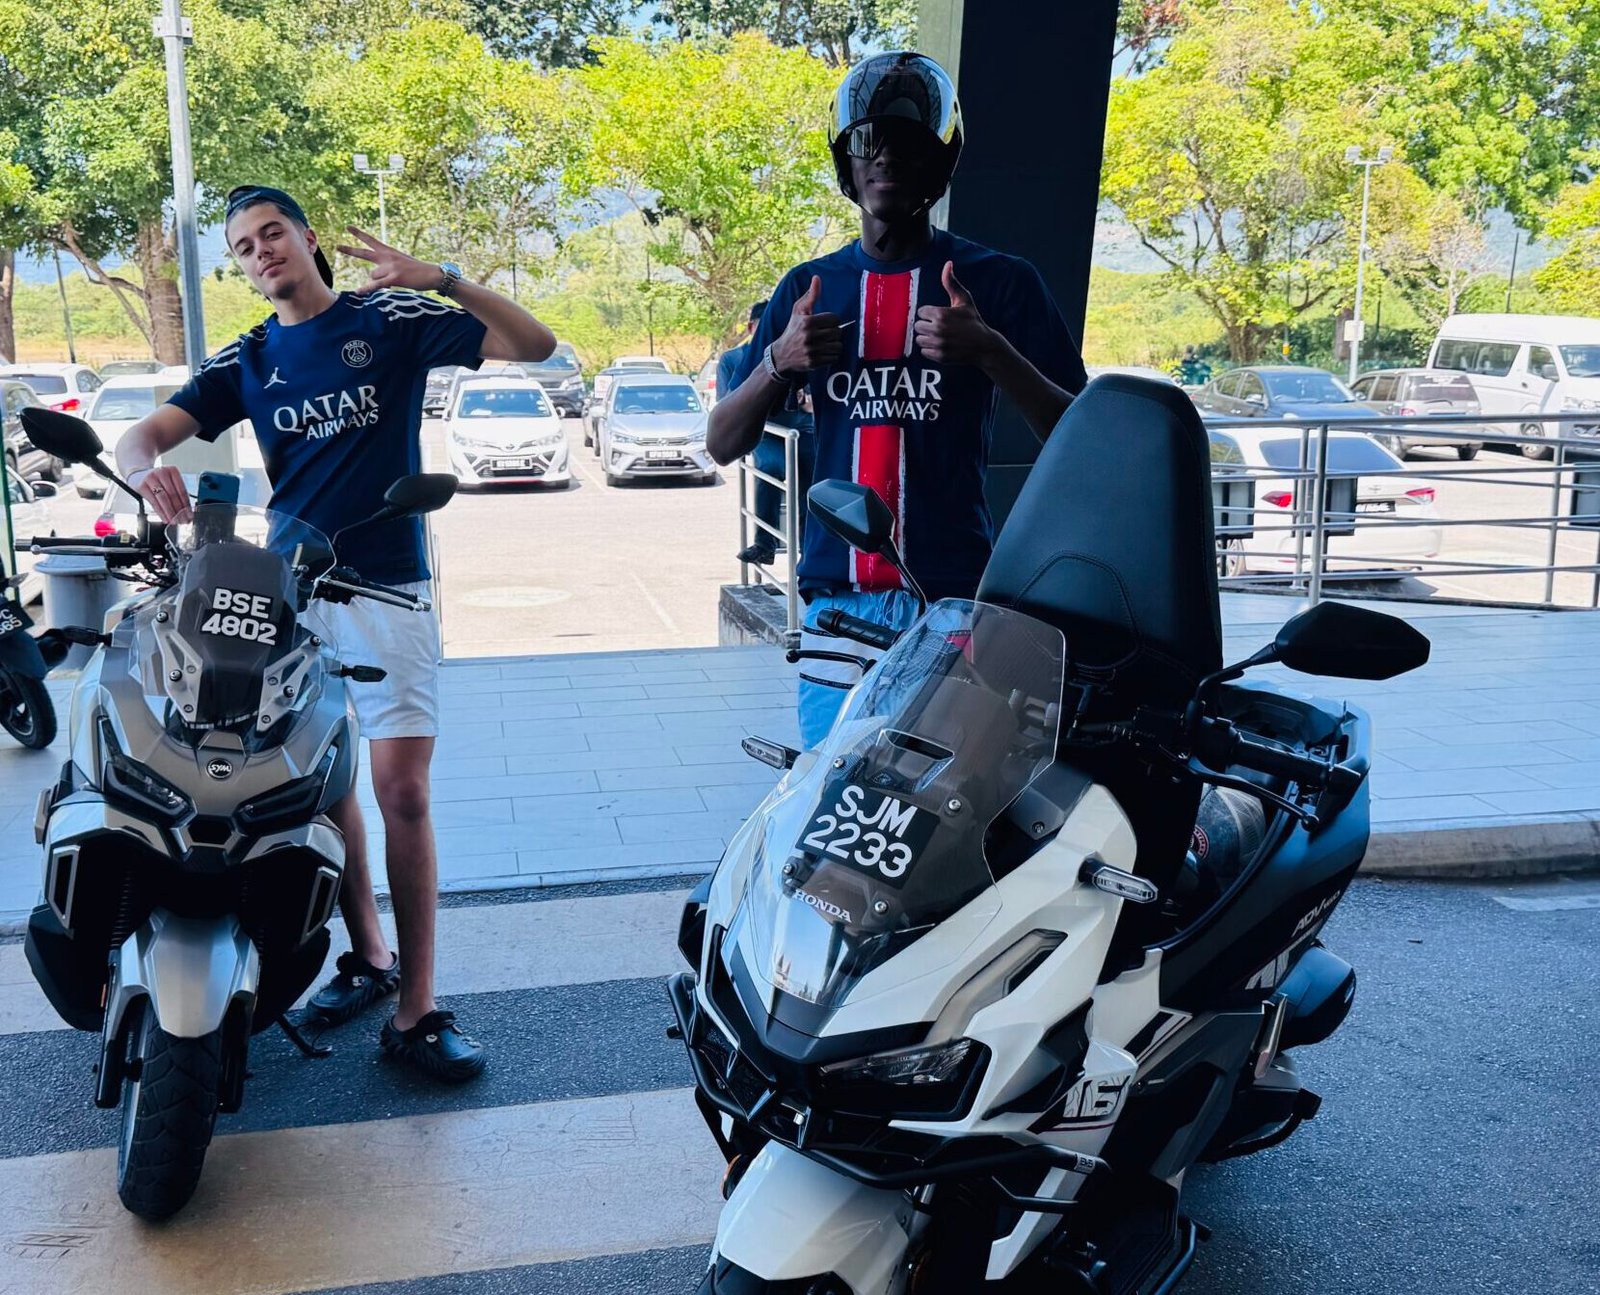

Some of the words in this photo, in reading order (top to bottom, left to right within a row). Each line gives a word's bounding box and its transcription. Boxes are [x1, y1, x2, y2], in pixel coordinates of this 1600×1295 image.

[826, 366, 942, 407] QATAR
[273, 384, 379, 434] QATAR
[306, 408, 379, 441] AIRWAYS
[850, 399, 940, 421] AIRWAYS
[212, 588, 271, 619] BSE
[201, 613, 277, 646] 4802
[210, 764, 231, 773] SYM
[835, 785, 918, 838] SJM
[803, 814, 913, 878] 2233
[792, 889, 852, 924] HONDA
